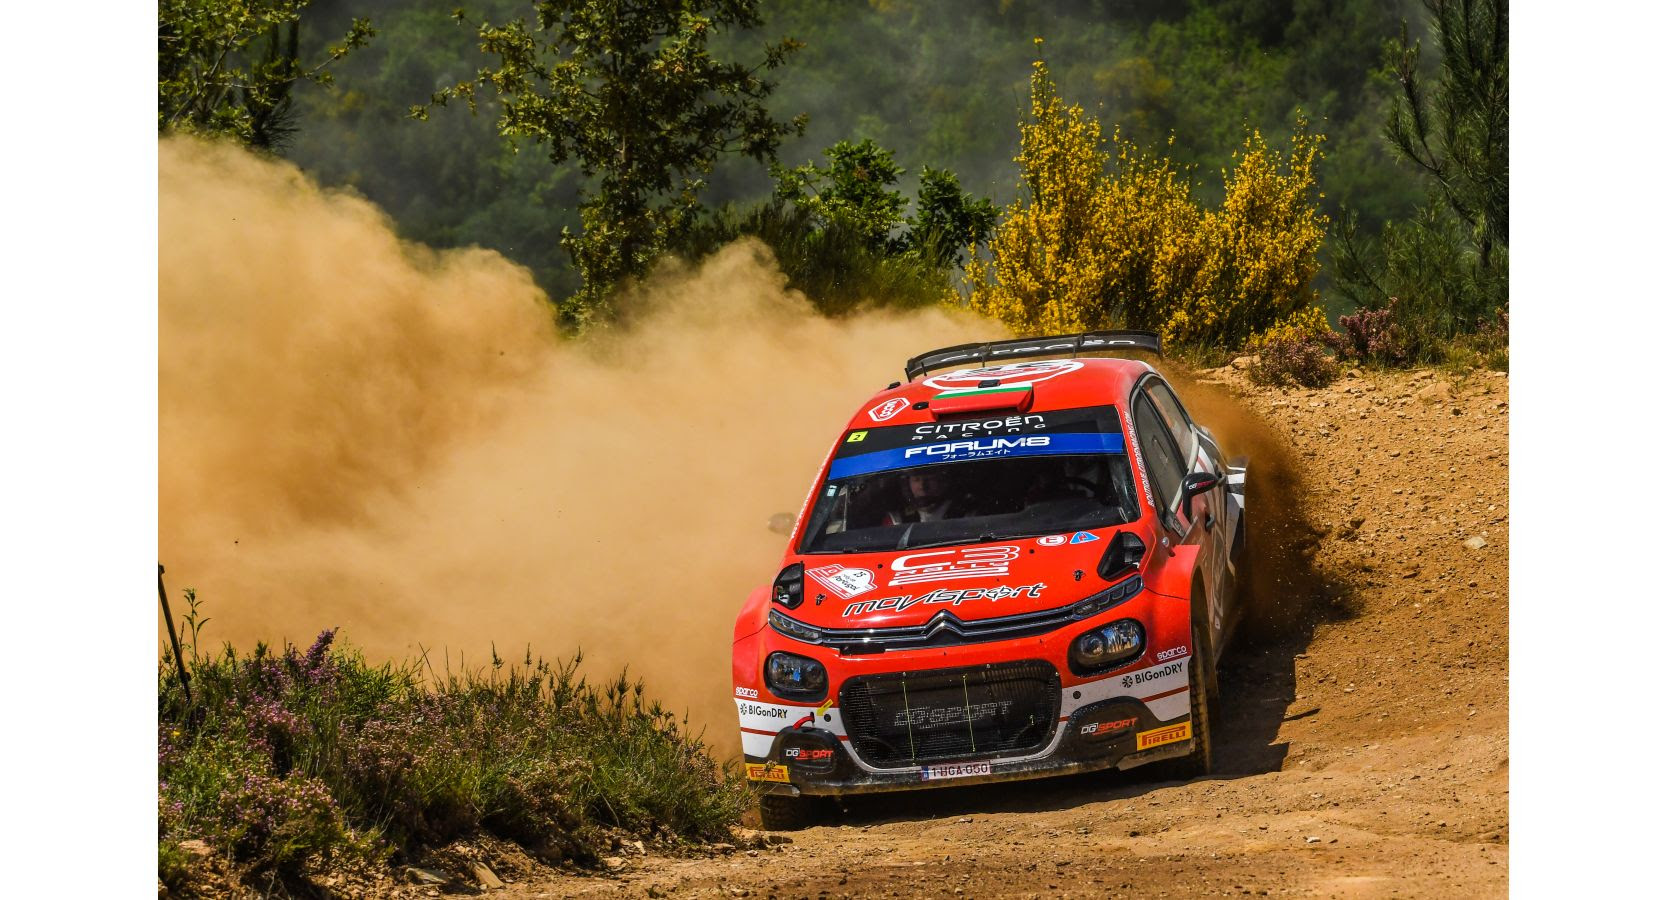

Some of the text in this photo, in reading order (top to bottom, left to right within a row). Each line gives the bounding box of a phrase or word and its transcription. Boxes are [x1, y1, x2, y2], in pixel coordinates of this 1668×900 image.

[915, 415, 1045, 434] CITROËN
[904, 436, 1051, 459] FORUM8
[942, 449, 1011, 461] フォーラムエイト
[890, 545, 1021, 571] C3
[842, 582, 1048, 618] movisport
[1156, 645, 1188, 661] sparco
[1134, 662, 1184, 685] BIGonDRY
[735, 686, 759, 698] sparco
[748, 705, 788, 718] BIGonDRY
[1141, 724, 1187, 747] PIRELLI
